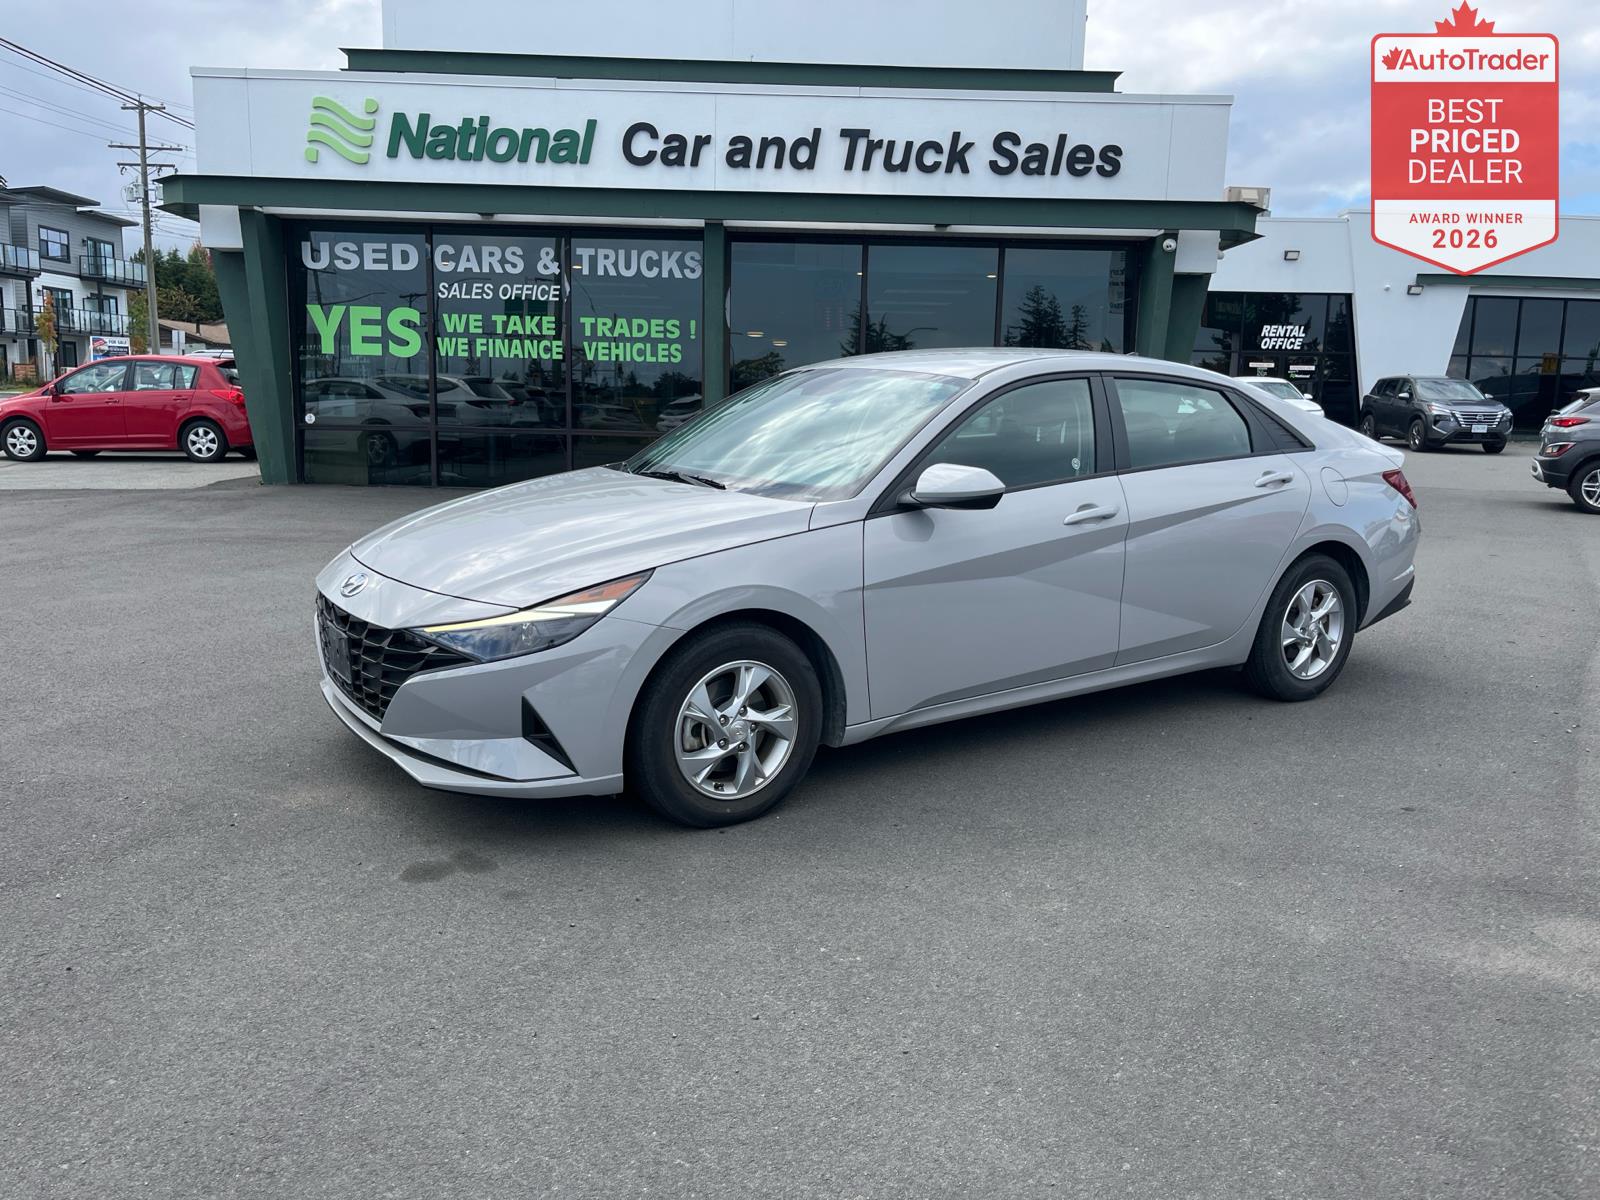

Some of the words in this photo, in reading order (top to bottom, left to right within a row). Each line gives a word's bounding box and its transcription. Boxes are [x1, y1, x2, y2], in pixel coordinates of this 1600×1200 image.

[386, 112, 597, 165] National
[621, 121, 712, 168] Car
[725, 128, 821, 170] and
[839, 128, 975, 174] Truck
[988, 131, 1123, 177] Sales
[301, 241, 419, 271] USED
[434, 244, 525, 274] CARS
[536, 247, 560, 275] &
[576, 247, 702, 279] TRUCKS
[437, 282, 493, 299] SALES
[499, 283, 561, 301] OFFICE
[306, 304, 422, 358] YES
[443, 313, 483, 334] WE
[491, 315, 556, 336] TAKE
[580, 317, 681, 339] TRADES
[1261, 324, 1306, 337] RENTAL
[436, 337, 469, 357] WE
[476, 338, 563, 360] FINANCE
[583, 341, 682, 363] VEHICLES
[1260, 337, 1303, 350] OFFICE
